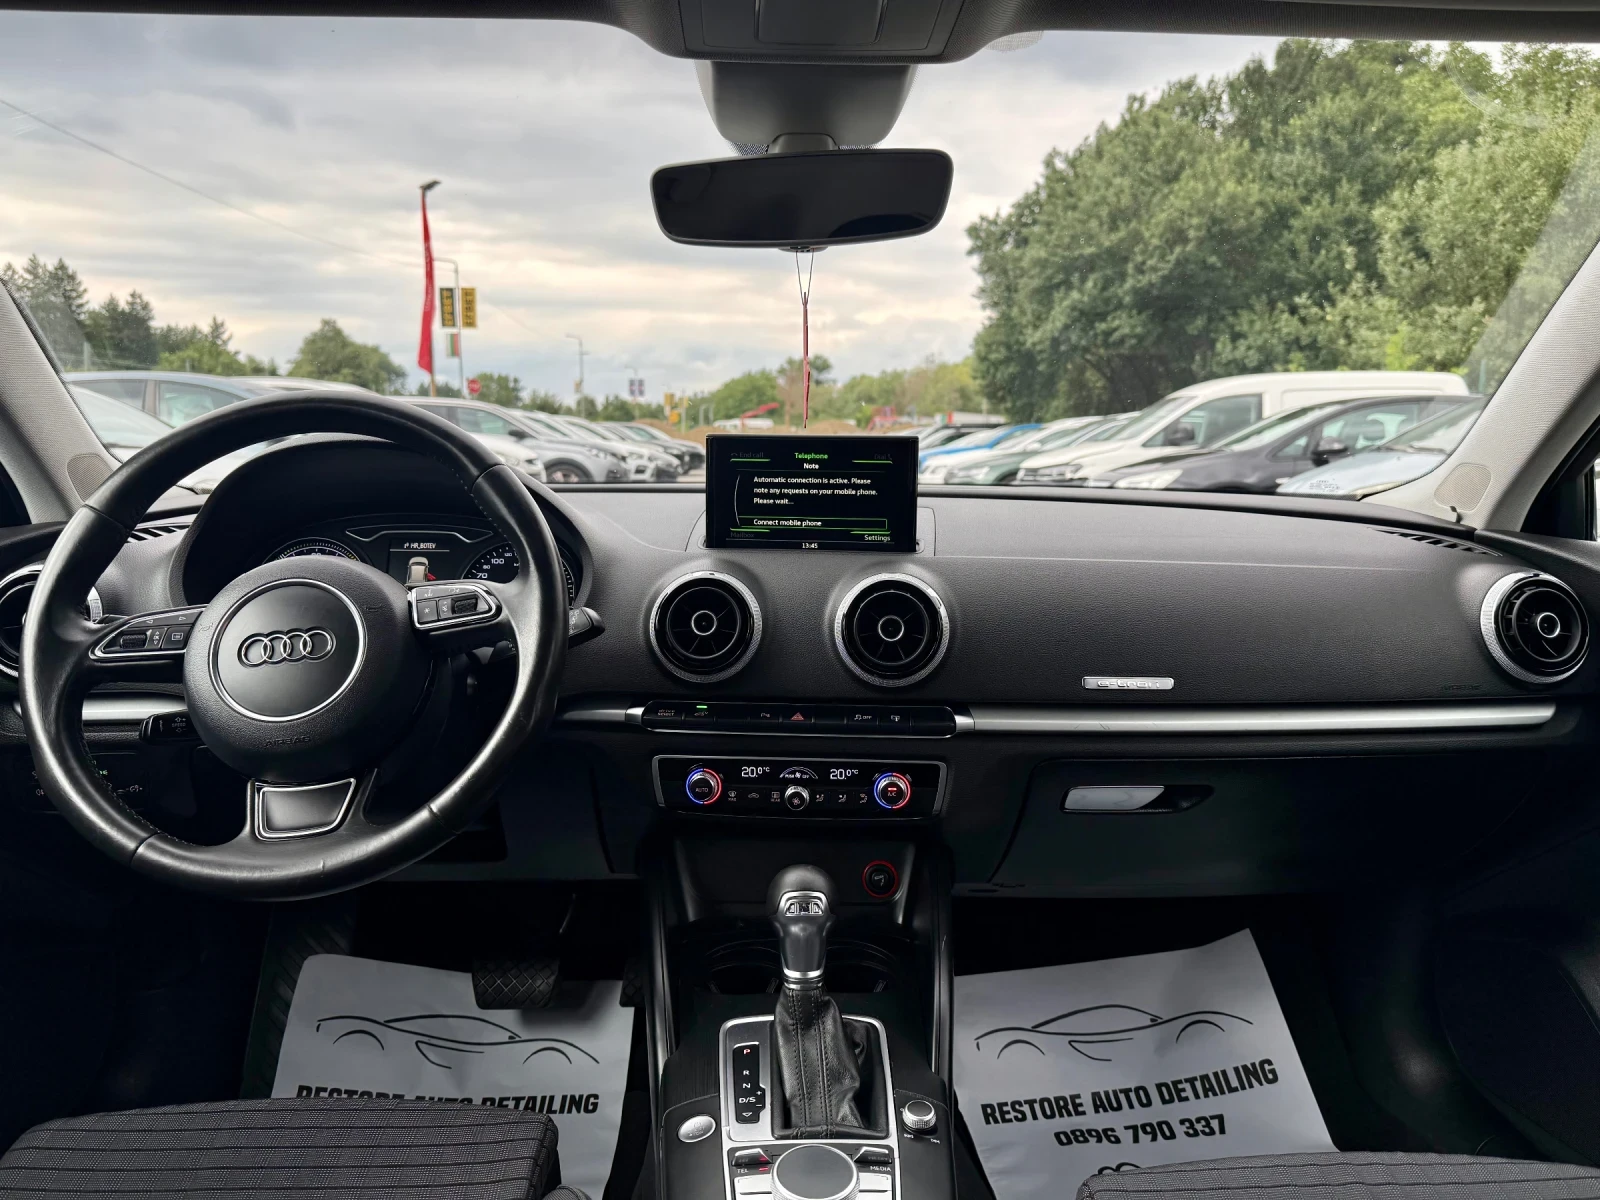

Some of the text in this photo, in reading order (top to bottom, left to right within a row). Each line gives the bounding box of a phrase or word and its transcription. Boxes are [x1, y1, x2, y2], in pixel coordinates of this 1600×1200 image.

[794, 452, 829, 460] Telephone
[802, 520, 822, 528] phone
[864, 534, 891, 543] Settings
[1096, 679, 1160, 688] e-tron
[981, 1058, 1279, 1126] RESTORE AUTO DETAILING
[738, 1096, 757, 1104] D/S
[1053, 1113, 1226, 1147] 0896 790 337
